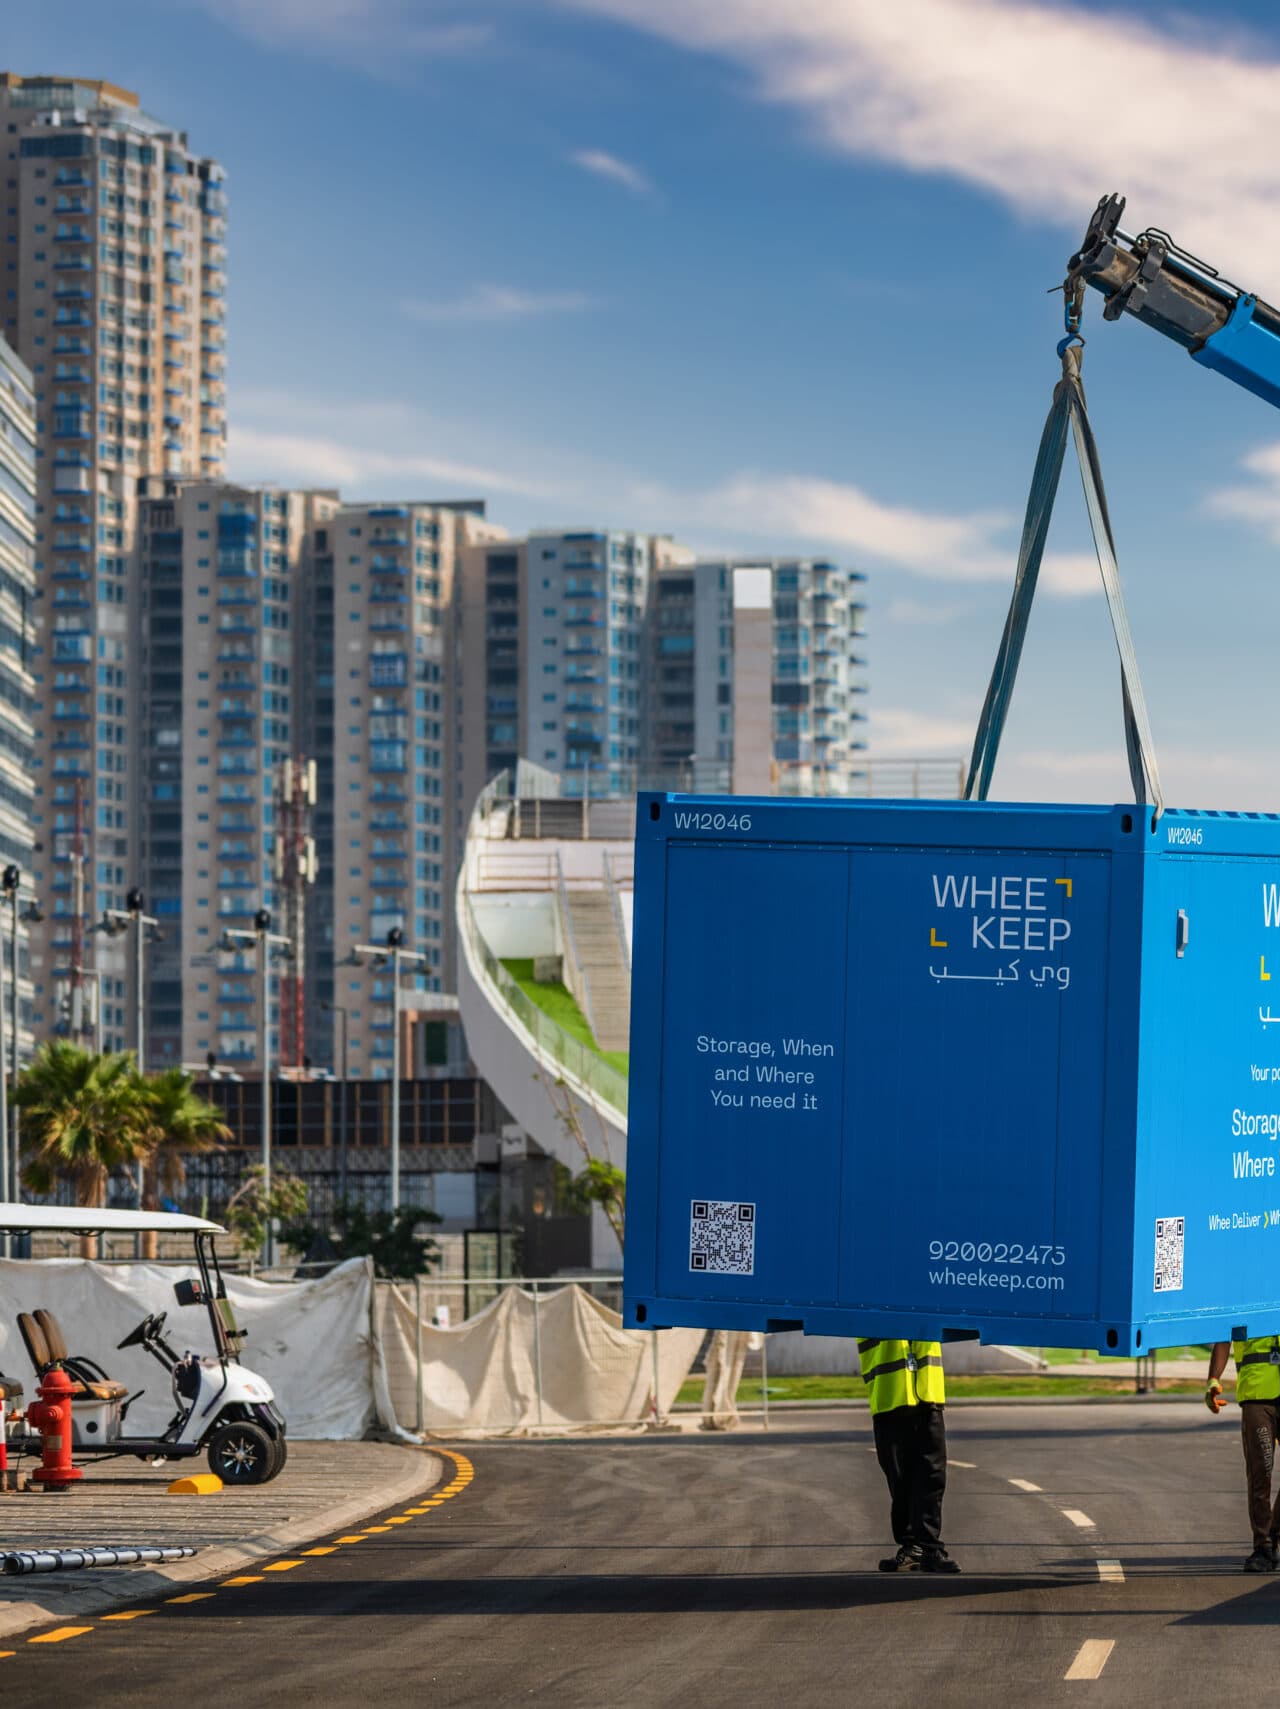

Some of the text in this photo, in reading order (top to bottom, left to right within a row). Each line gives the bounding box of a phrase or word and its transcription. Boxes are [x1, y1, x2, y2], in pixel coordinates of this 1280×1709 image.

[674, 812, 752, 831] W12046
[1167, 827, 1203, 845] W12046
[932, 874, 1048, 911] WHEE
[972, 915, 1072, 951] KEEP
[696, 1035, 835, 1059] Storage, When
[714, 1065, 815, 1084] and Where
[1250, 1064, 1270, 1081] Your
[710, 1089, 818, 1110] You need it
[1232, 1150, 1275, 1179] Where
[1208, 1212, 1261, 1231] Whee Deliver
[929, 1240, 1066, 1266] 920022475
[928, 1266, 1065, 1293] wheekeep.com
